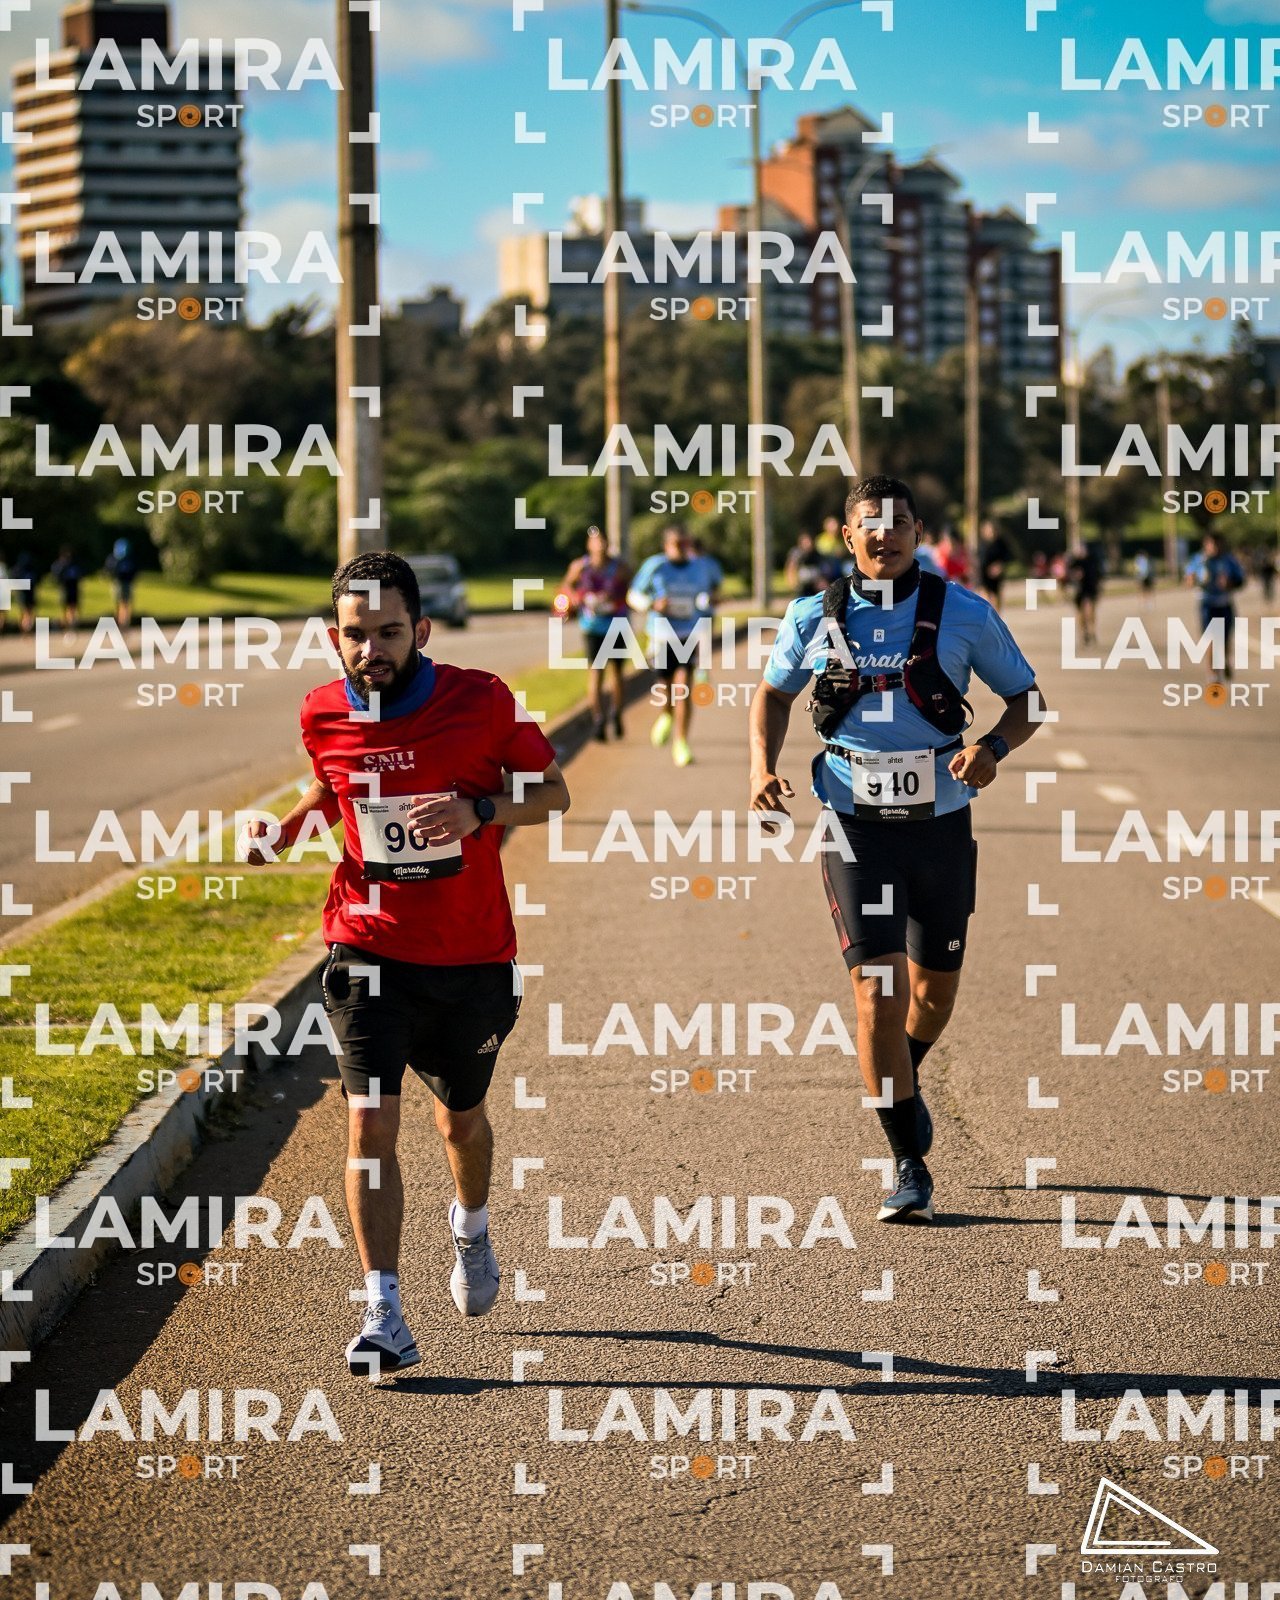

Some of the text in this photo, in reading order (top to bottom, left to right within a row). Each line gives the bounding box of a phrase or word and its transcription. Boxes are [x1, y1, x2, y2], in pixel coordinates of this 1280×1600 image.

[866, 771, 920, 797] 940
[399, 803, 418, 811] ante
[393, 866, 430, 876] Maratón
